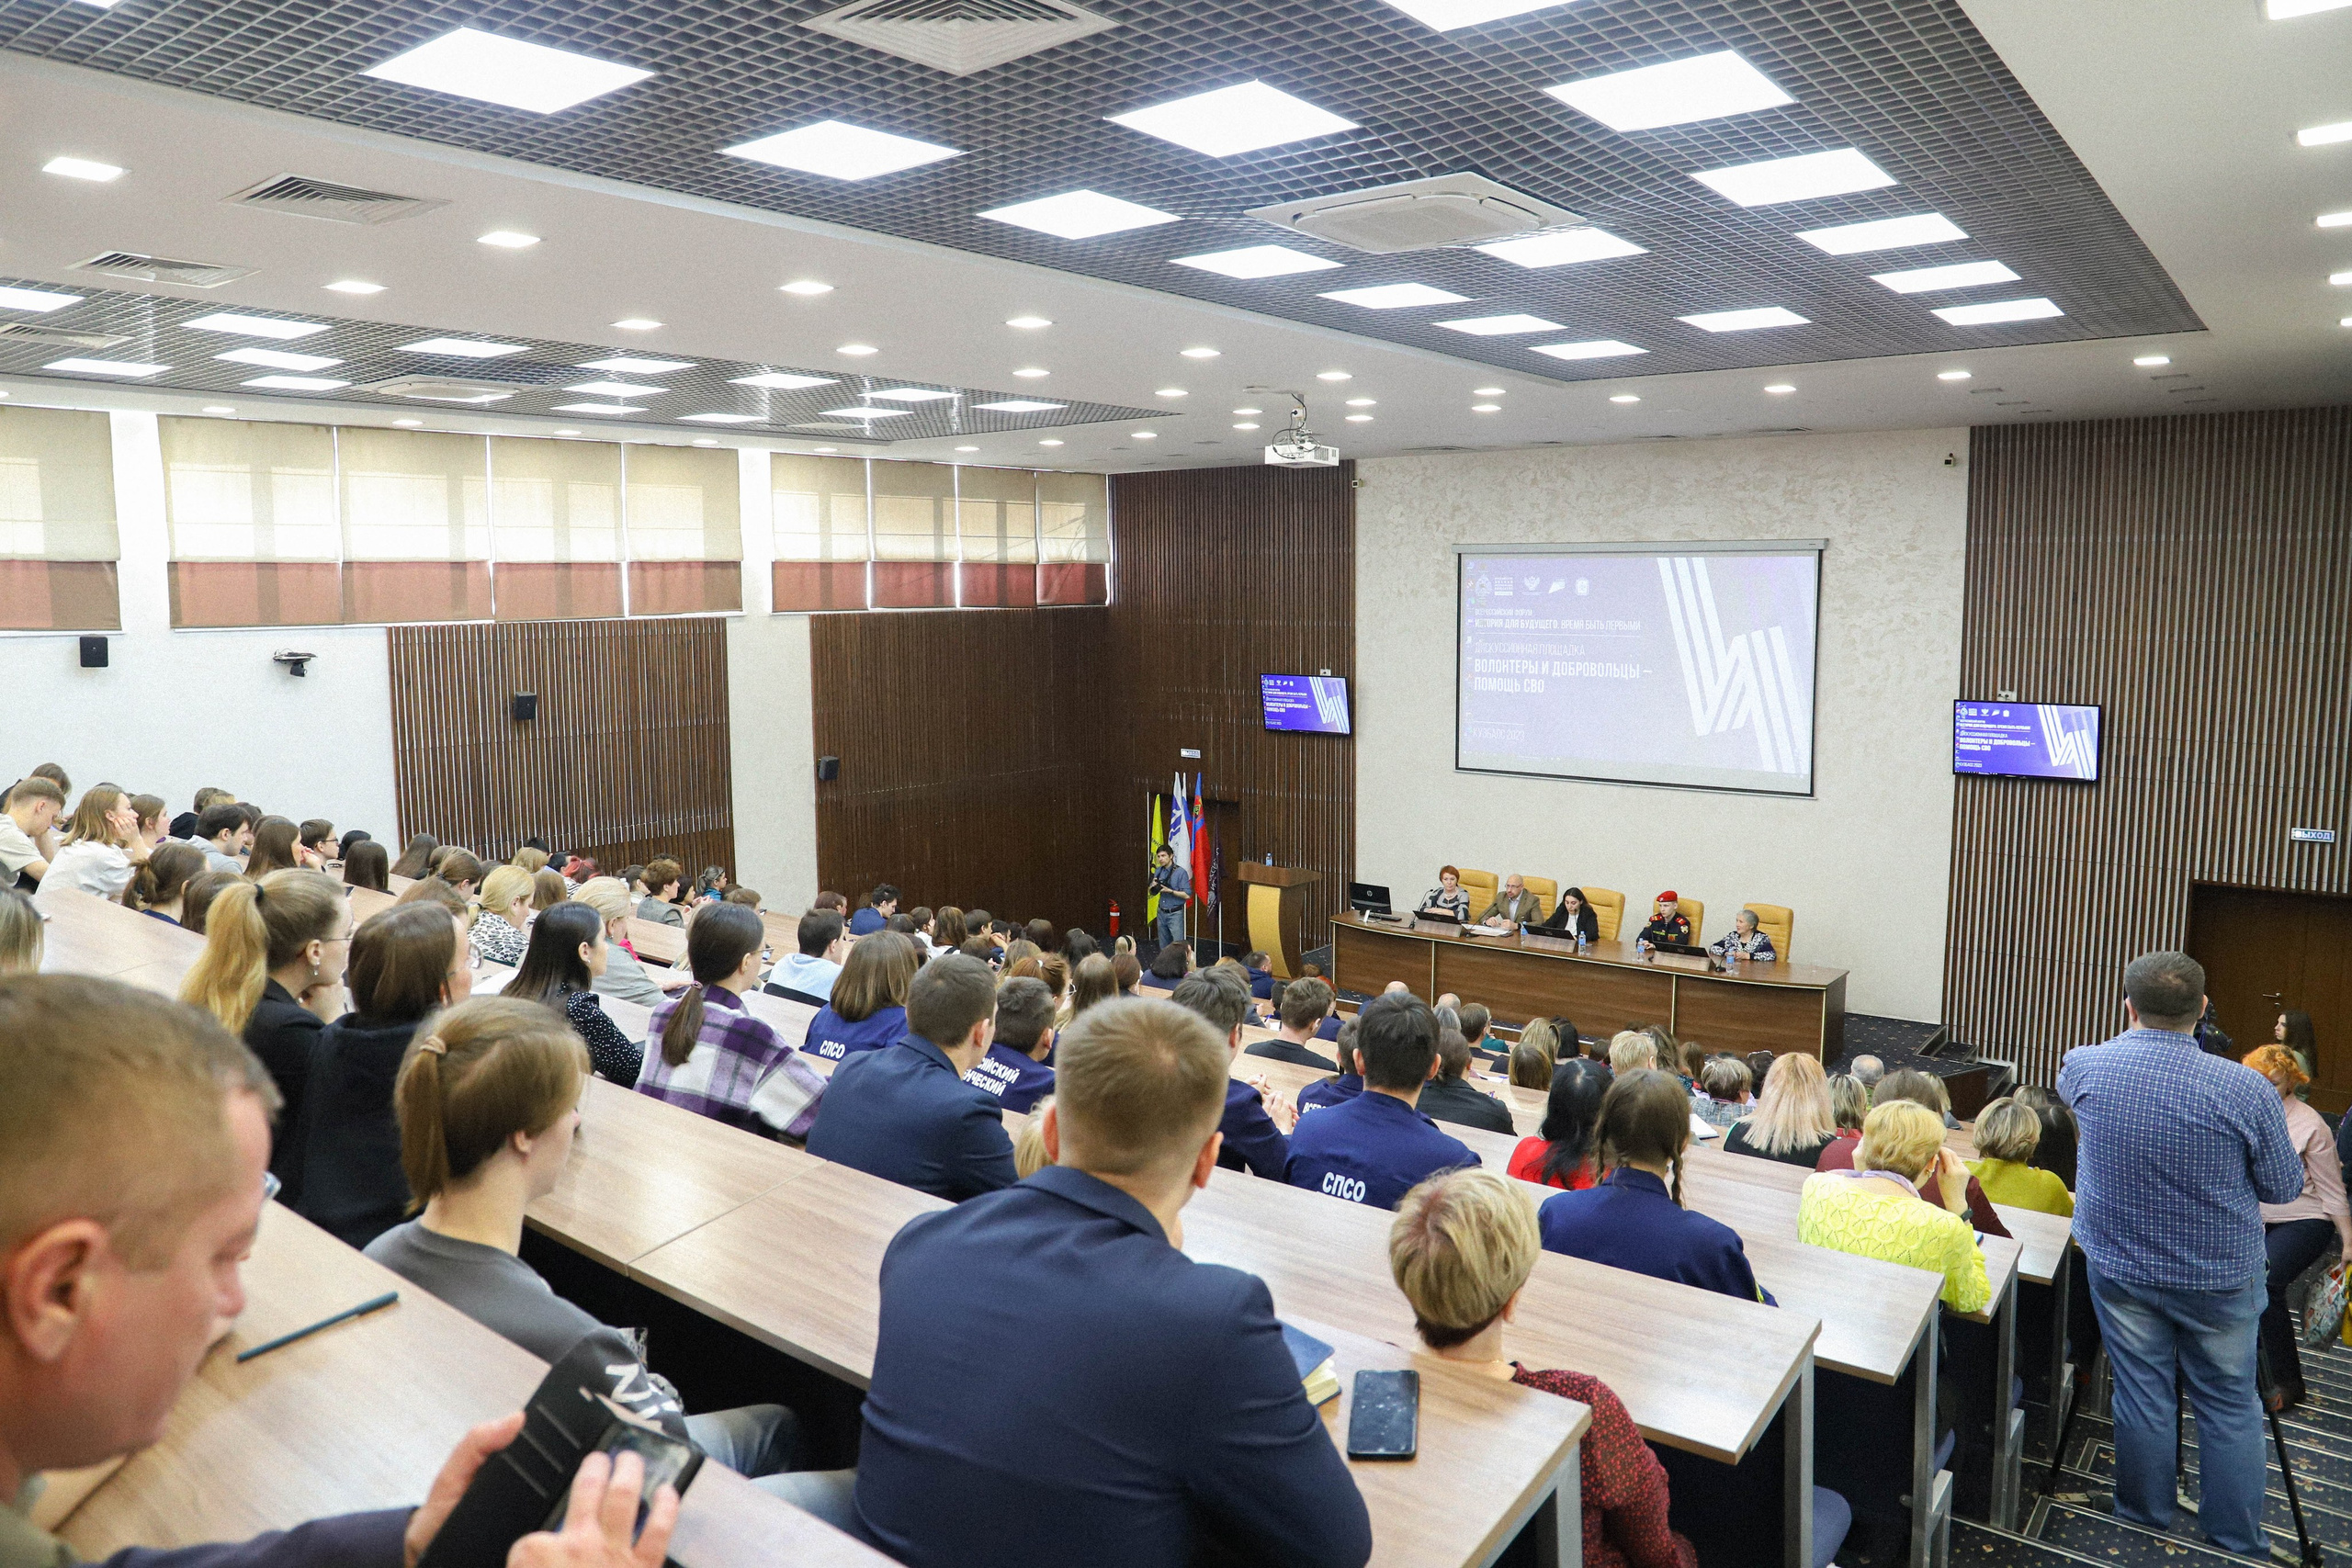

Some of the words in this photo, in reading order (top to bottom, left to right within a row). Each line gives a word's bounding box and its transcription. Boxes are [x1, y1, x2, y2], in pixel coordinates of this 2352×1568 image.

[1475, 618, 1504, 628] ИТОРИЯ
[1505, 618, 1520, 629] ДЛЯ
[1520, 619, 1560, 630] БУДУЩЕГО.
[1561, 620, 1584, 630] ВРЕМЯ
[1585, 620, 1605, 630] БЫТЬ
[1606, 621, 1641, 631] ПЕРВЫМИ
[1474, 659, 1538, 675] ВОЛОНТЕРЫ
[1542, 660, 1549, 675] И
[1552, 661, 1640, 680] ДОБРОВОЛЬЦЫ
[1474, 677, 1521, 694] ПОМОЩЬ
[1524, 679, 1544, 694] СВО
[819, 1040, 845, 1059] СПСО
[1322, 1171, 1366, 1202] СПСО
